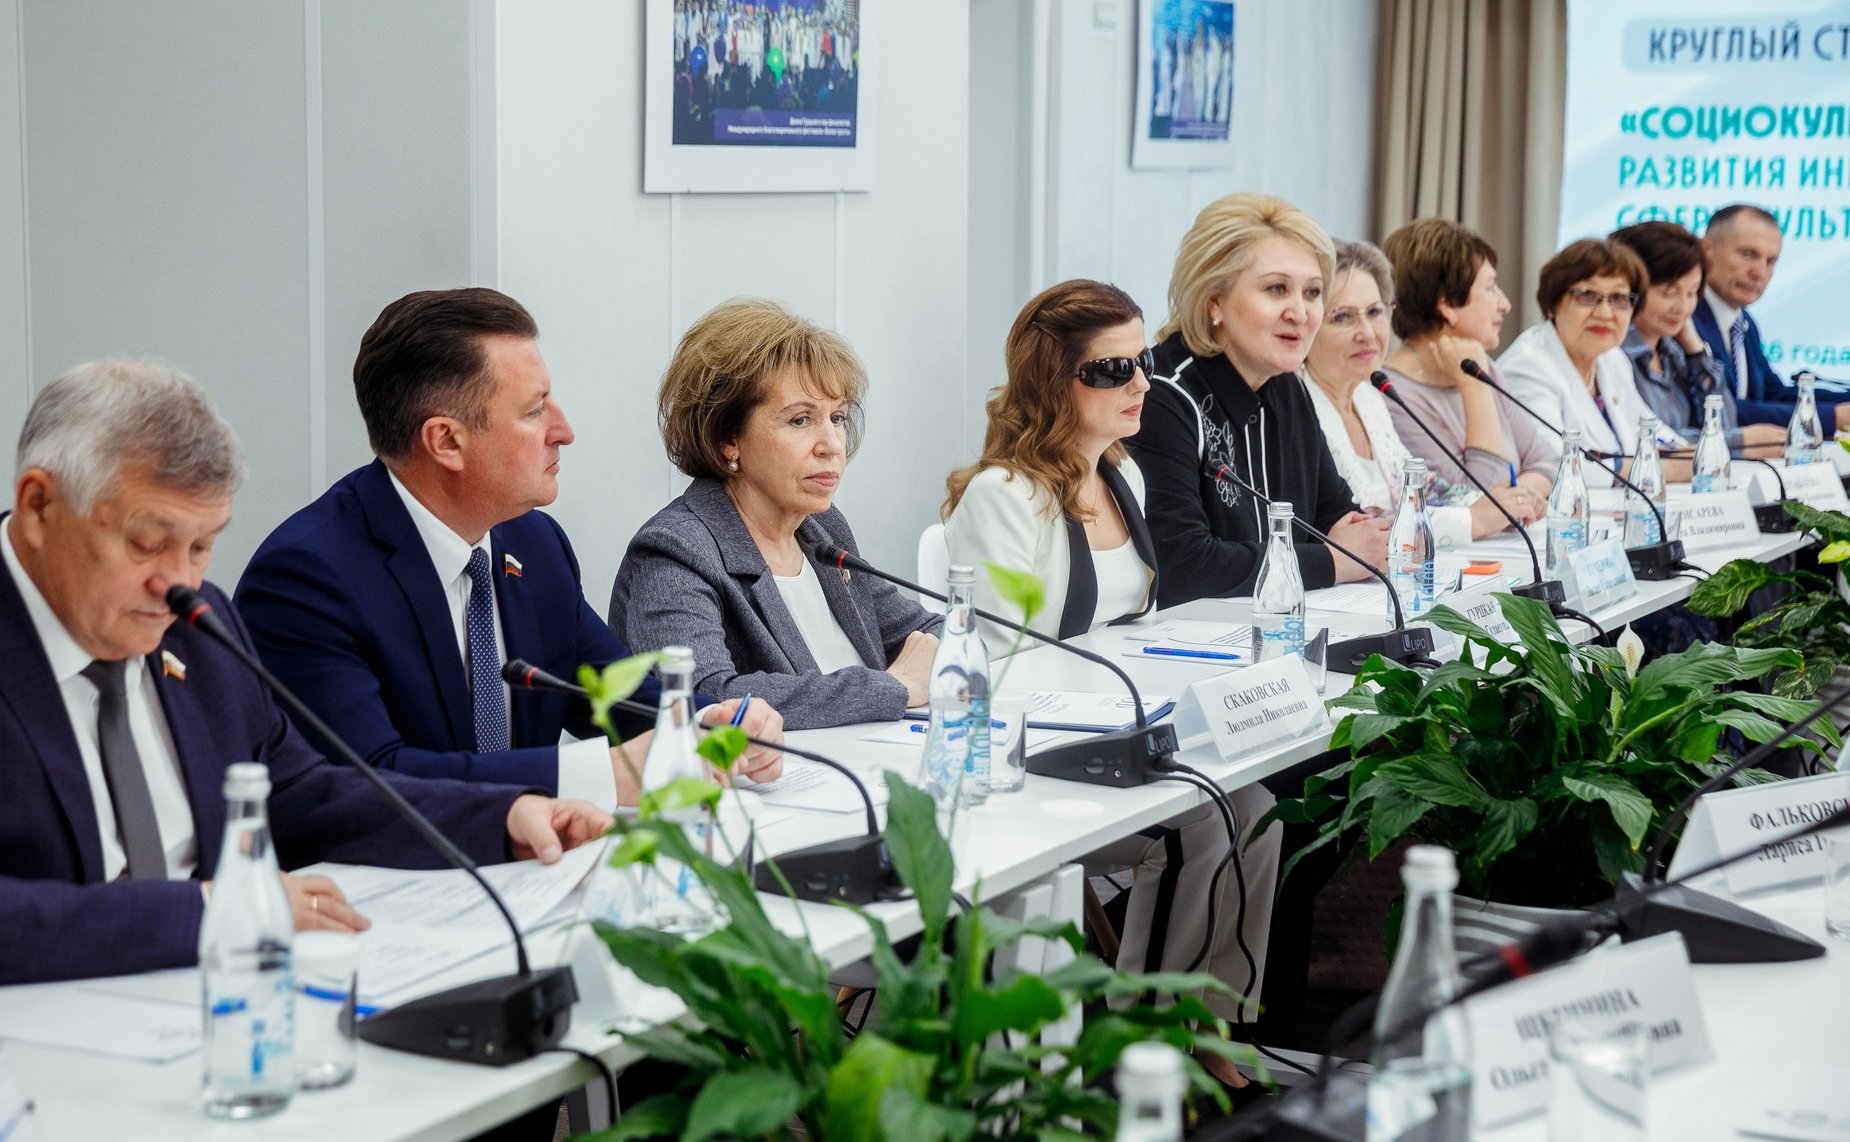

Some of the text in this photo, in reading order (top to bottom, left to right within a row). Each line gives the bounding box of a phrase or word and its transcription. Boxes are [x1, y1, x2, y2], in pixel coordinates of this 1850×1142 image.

[1649, 21, 1800, 62] КРУГЛЫЙ
[1620, 105, 1850, 142] «СОЦИОКУЛ
[1619, 154, 1850, 188] РАЗВИТИЯ ИН
[1772, 206, 1850, 239] УЛЬТ
[1223, 677, 1292, 711] СКАКОВСКАЯ
[1225, 700, 1309, 736] Людмила Николаевна
